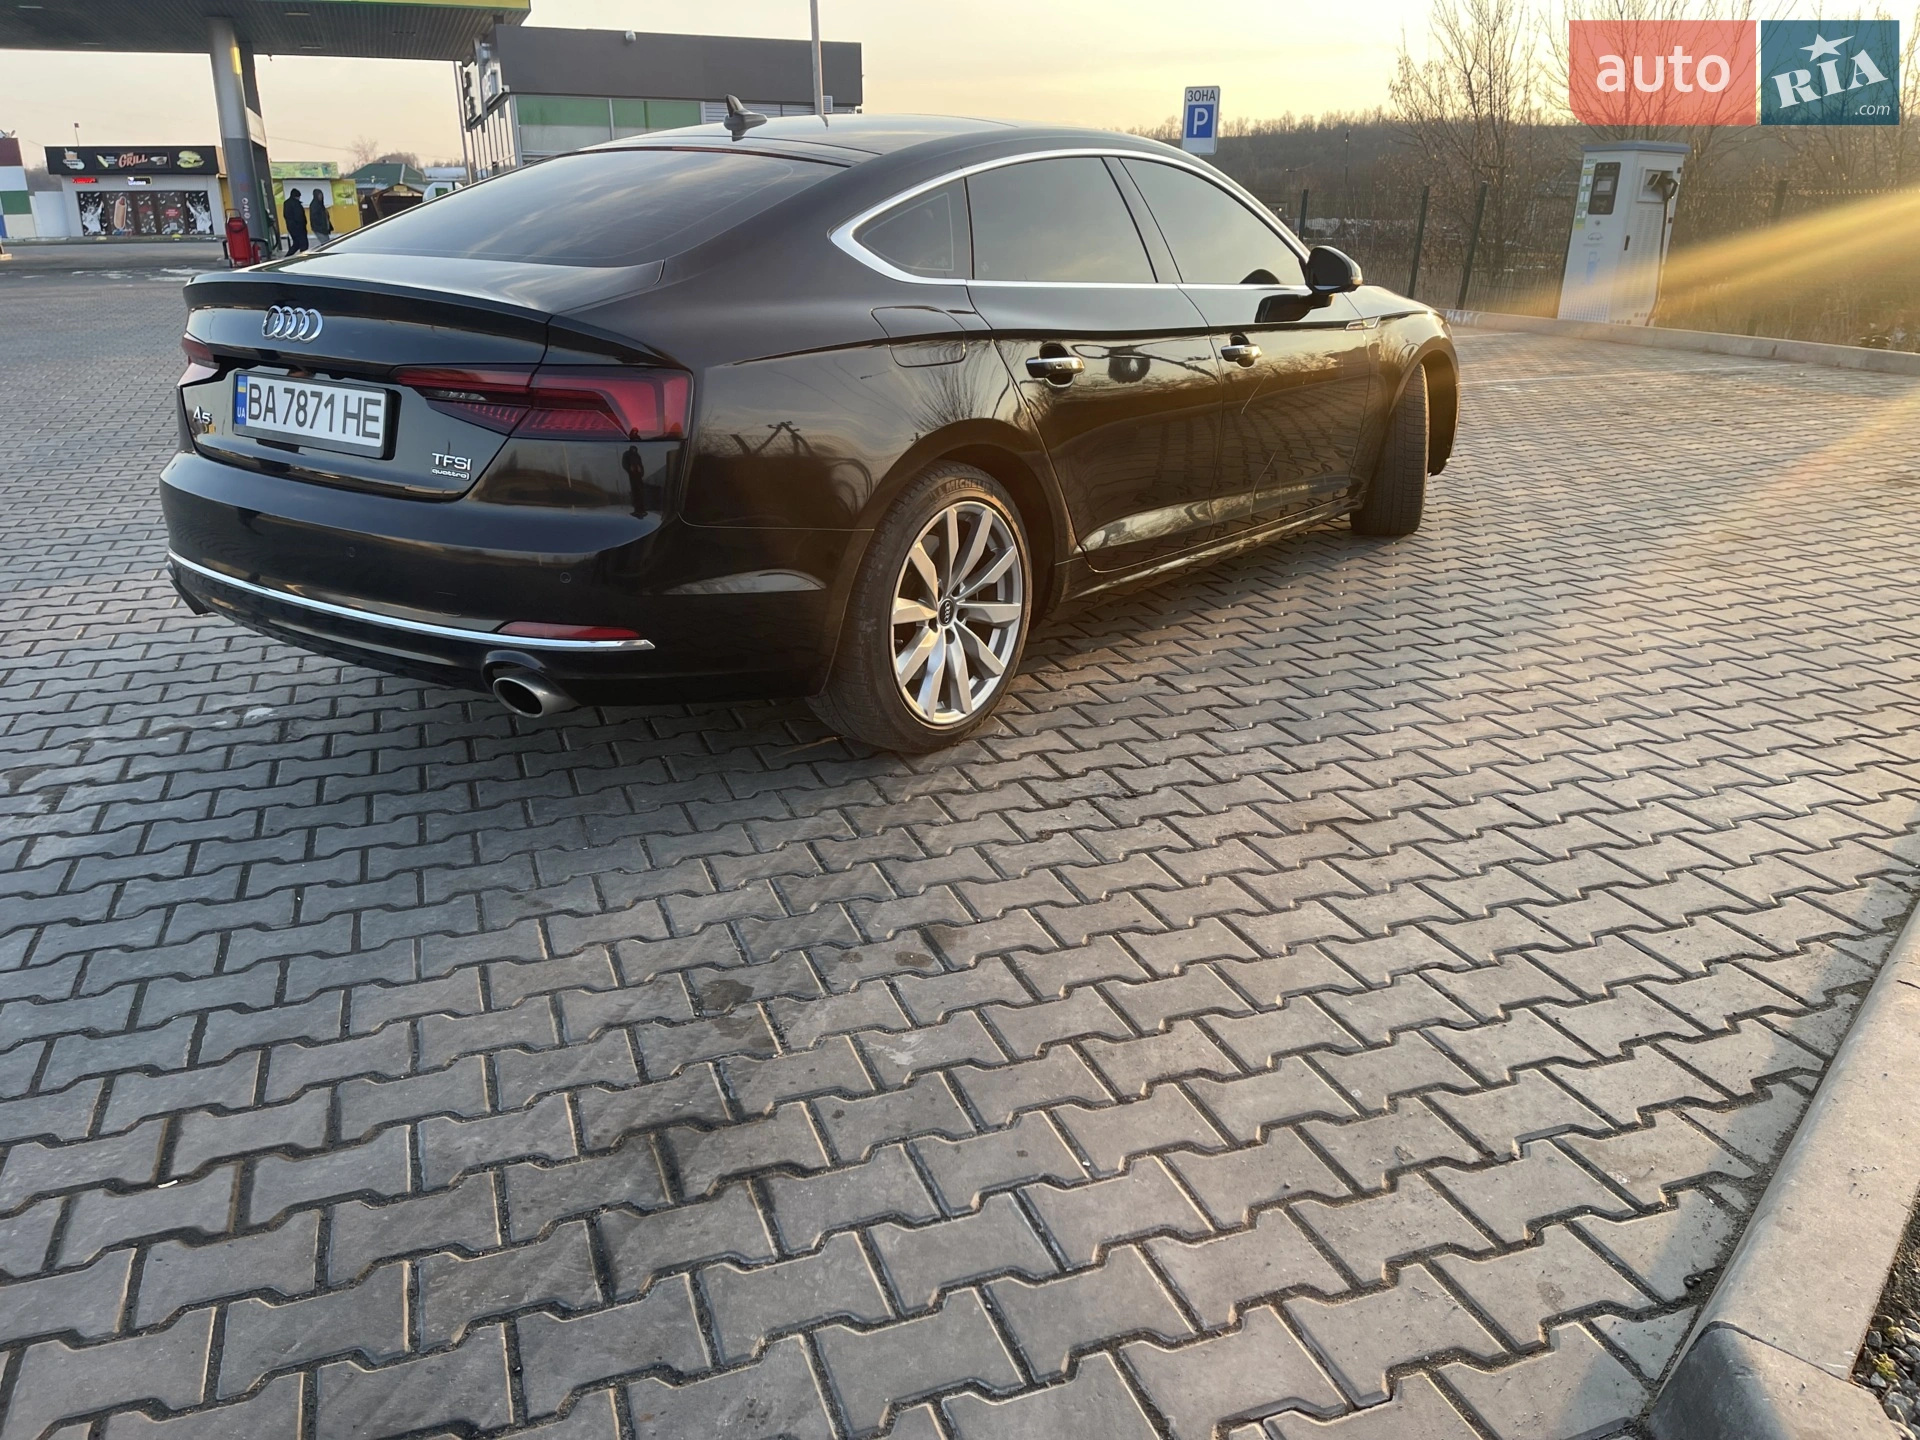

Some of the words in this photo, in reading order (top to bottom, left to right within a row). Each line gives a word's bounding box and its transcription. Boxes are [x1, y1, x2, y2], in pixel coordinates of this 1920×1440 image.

[1187, 90, 1216, 102] ЗОНА
[1193, 107, 1209, 135] P
[118, 153, 148, 168] GRILL
[193, 406, 212, 424] A5
[237, 406, 246, 418] UA
[248, 383, 277, 424] BA
[283, 387, 335, 432] 7871
[342, 395, 382, 440] HE
[432, 452, 472, 471] TFSI
[432, 468, 467, 479] quattro
[945, 478, 993, 494] MICHELIN
